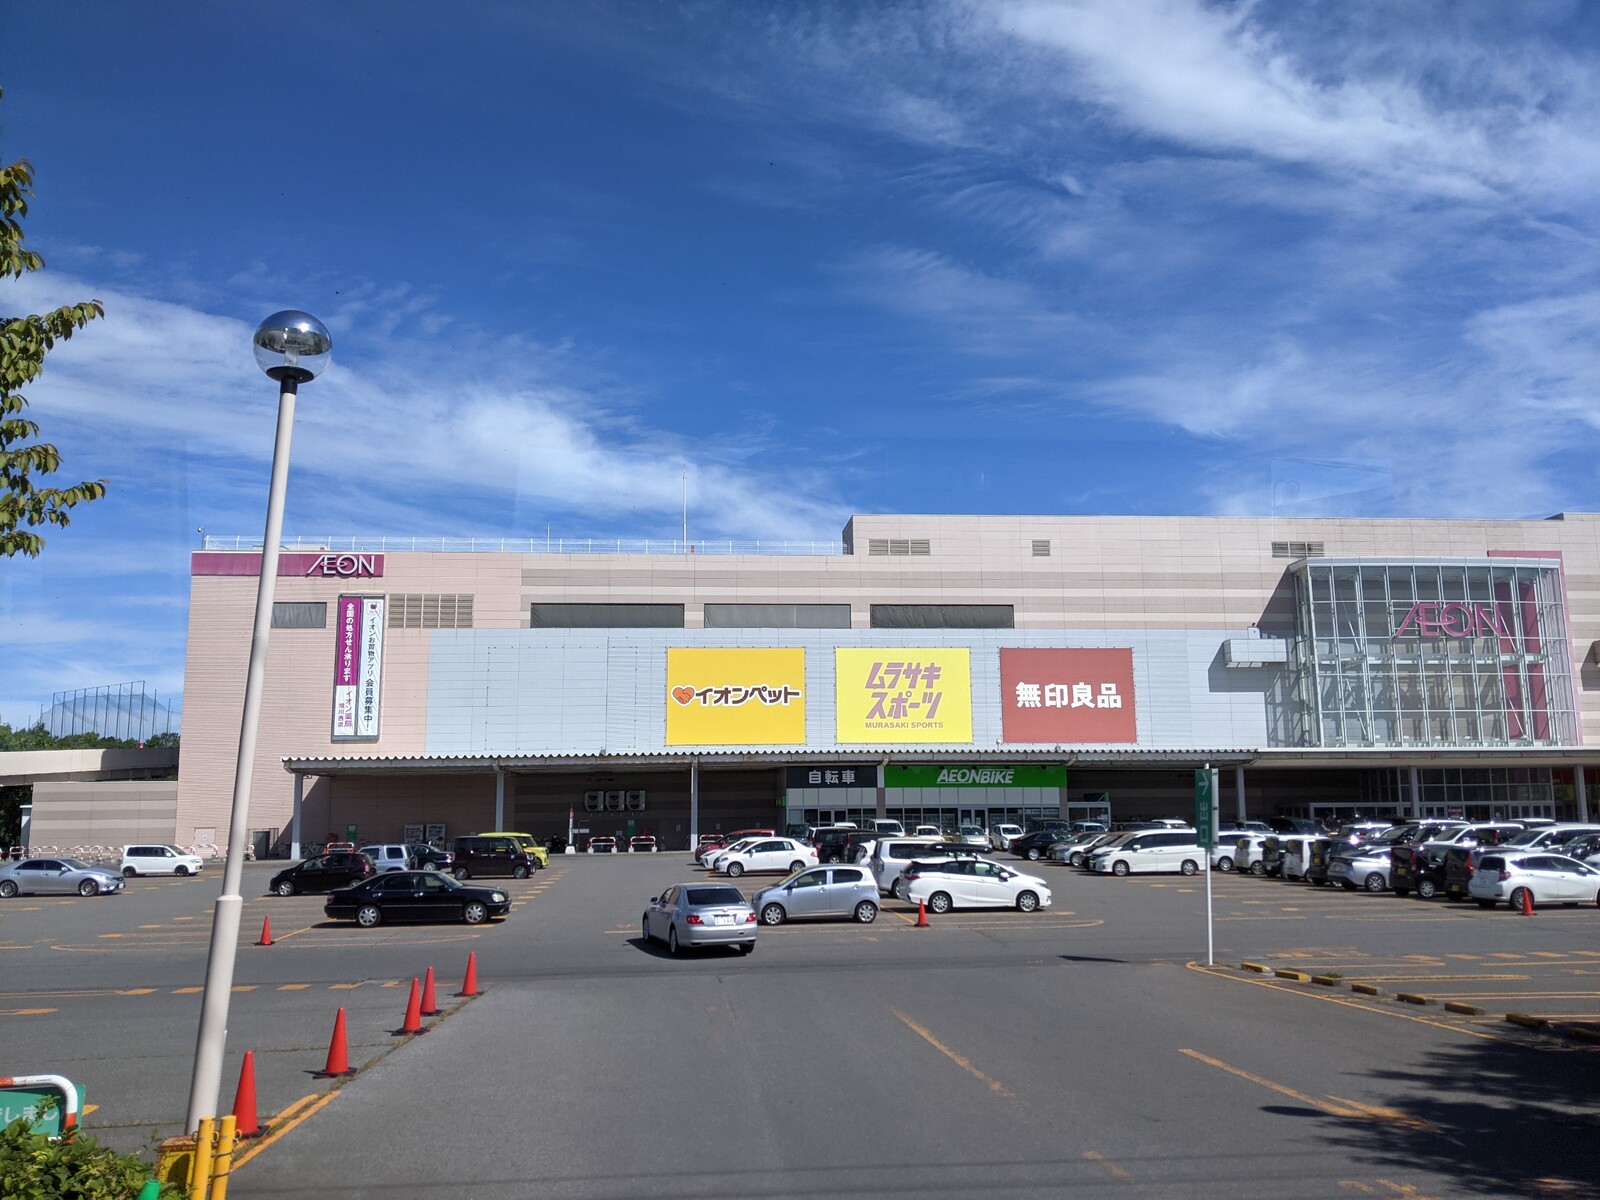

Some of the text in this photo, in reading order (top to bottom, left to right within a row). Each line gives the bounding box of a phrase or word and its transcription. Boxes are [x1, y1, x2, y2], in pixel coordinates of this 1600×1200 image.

[306, 554, 375, 575] AEON
[1391, 602, 1502, 638] AEON
[343, 602, 355, 683] 全国の処方せん承ります
[865, 662, 942, 689] ムラサキ
[695, 685, 800, 705] イオンペット
[865, 691, 943, 719] スポーツ
[1015, 681, 1122, 708] 無印良品
[344, 690, 353, 728] イオン薬局
[808, 769, 856, 784] 自転車
[935, 769, 1015, 784] AEONBIKE
[1200, 801, 1209, 843] 出口
